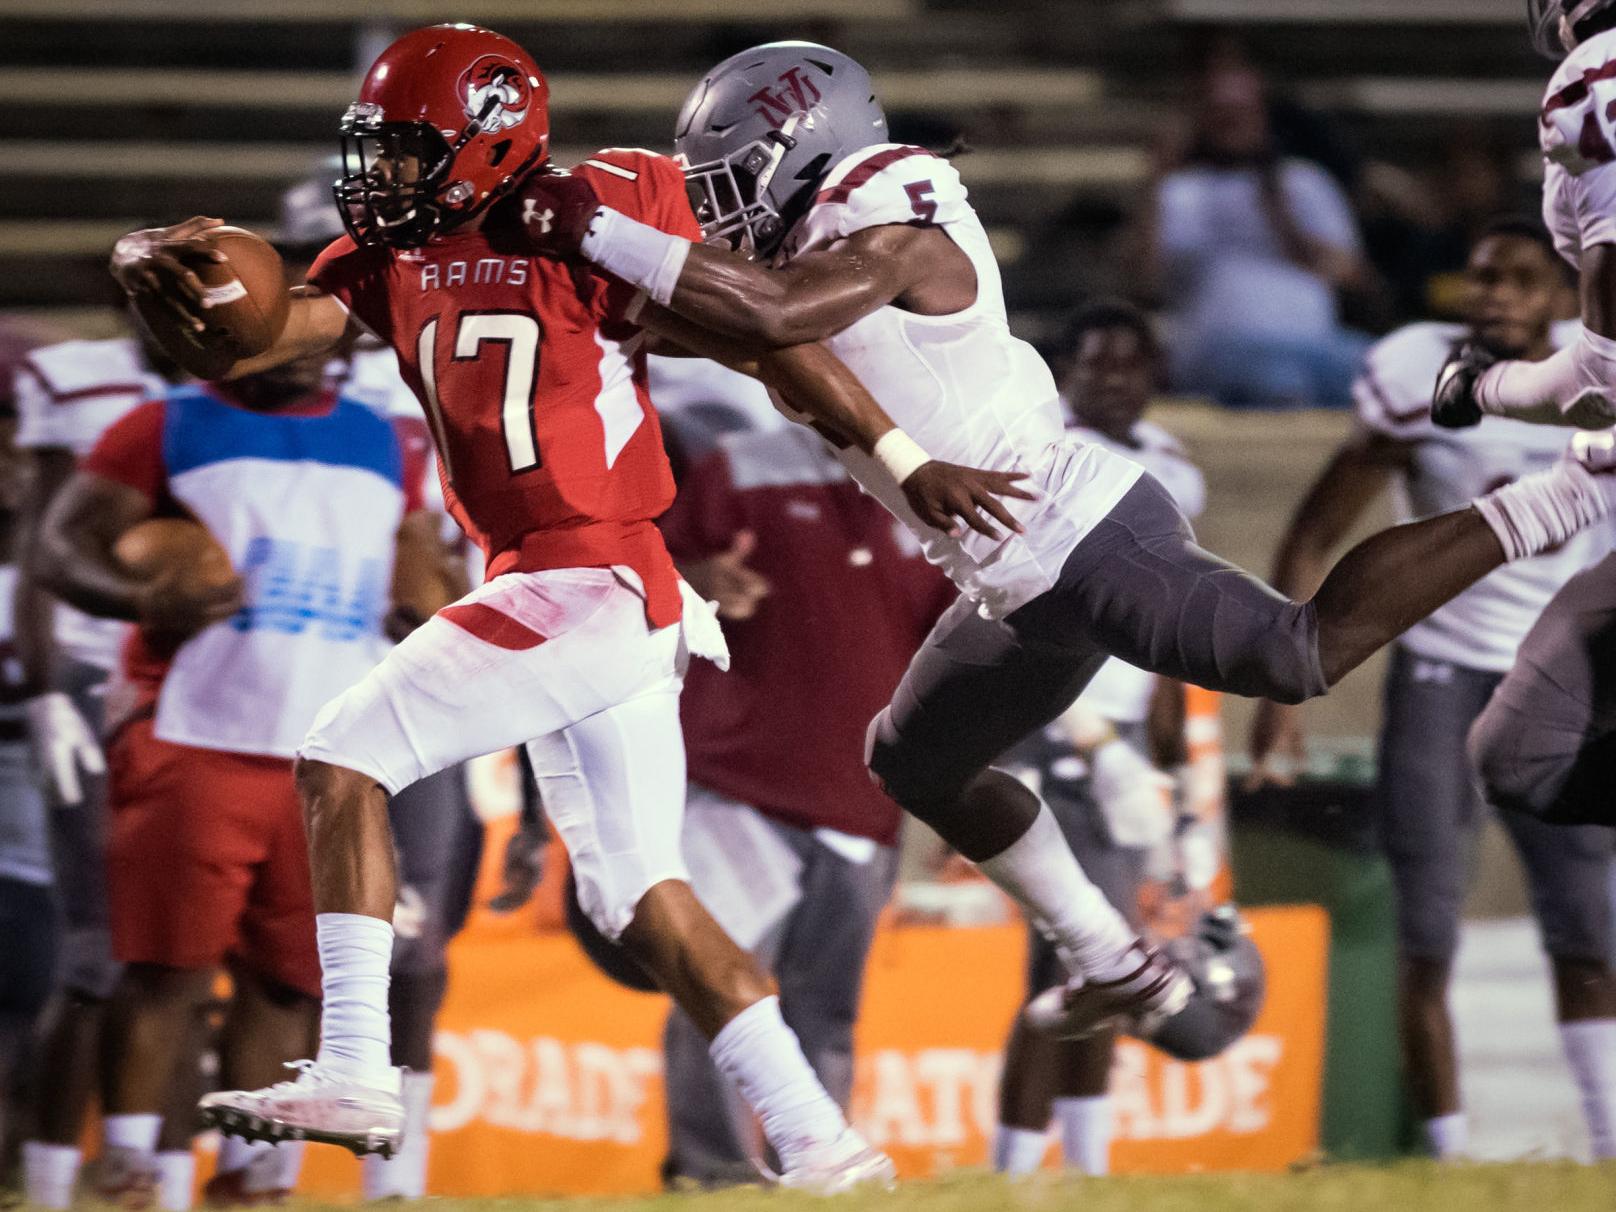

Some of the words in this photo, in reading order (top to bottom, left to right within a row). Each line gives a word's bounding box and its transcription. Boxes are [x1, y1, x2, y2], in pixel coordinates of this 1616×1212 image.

[902, 178, 938, 224] 5
[420, 258, 529, 291] RAMS
[416, 309, 545, 487] 17
